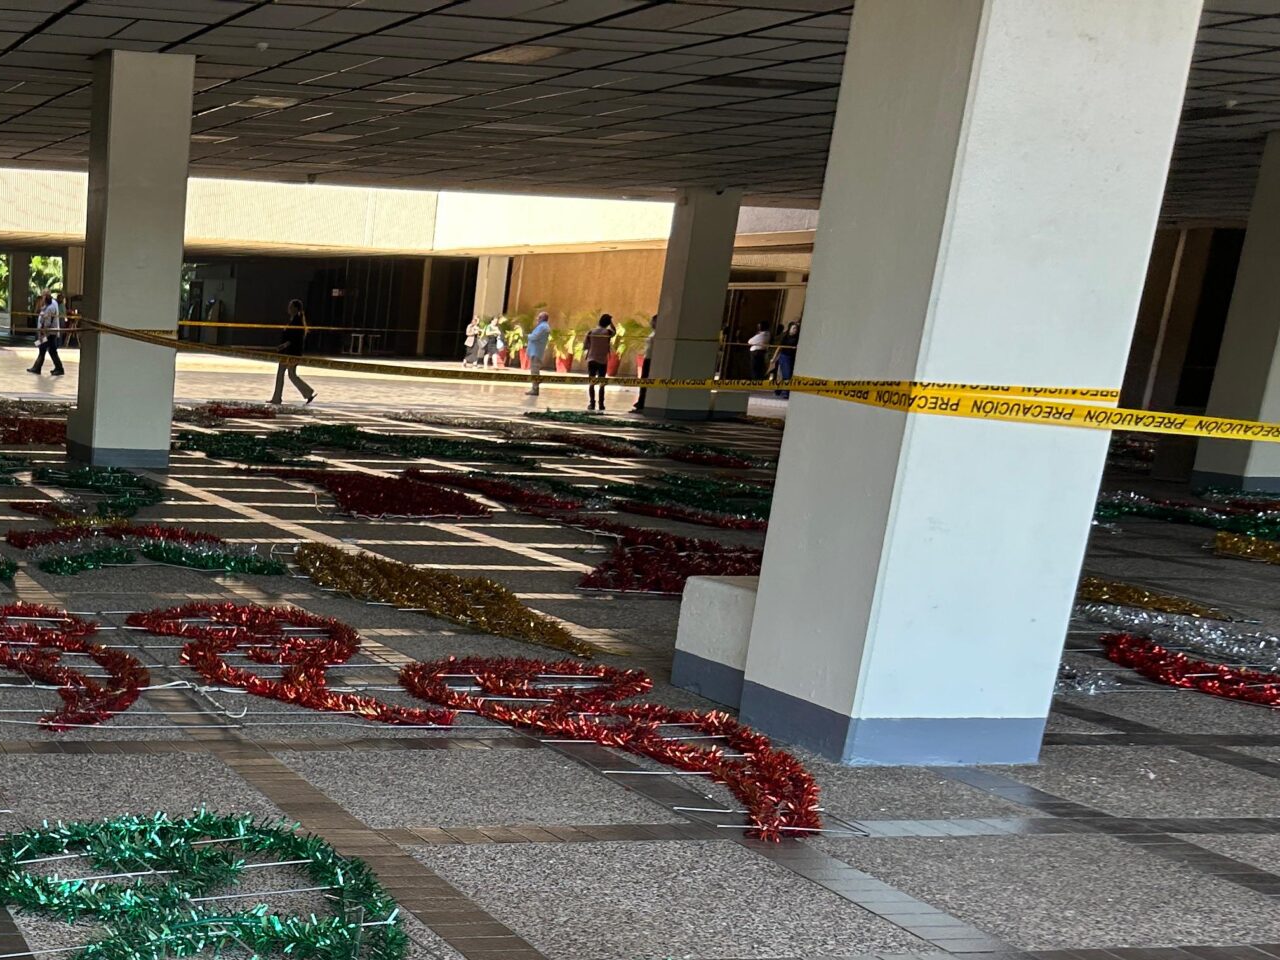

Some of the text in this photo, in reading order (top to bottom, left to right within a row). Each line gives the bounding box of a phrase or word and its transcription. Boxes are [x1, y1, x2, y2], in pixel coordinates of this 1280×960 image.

[874, 390, 961, 412] PRECAUCIÓN
[971, 399, 1075, 421] PRECAUCIÓN
[1083, 409, 1187, 430] PRECAUCIÓN
[1194, 419, 1280, 438] RECAUCIÓN
